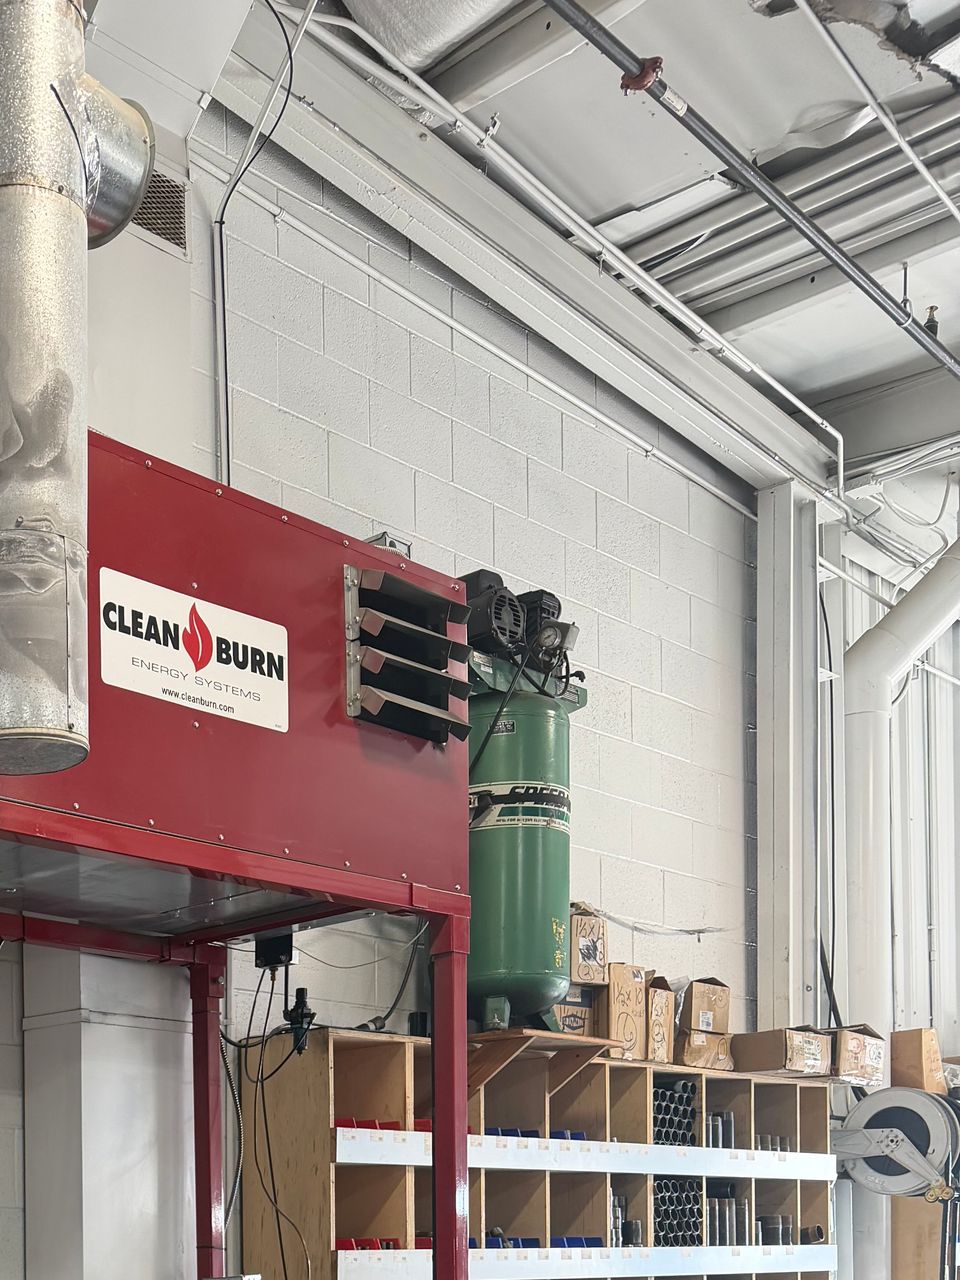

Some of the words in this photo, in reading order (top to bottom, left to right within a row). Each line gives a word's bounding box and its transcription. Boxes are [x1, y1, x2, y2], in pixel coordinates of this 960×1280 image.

[102, 601, 180, 651] CLEAN
[216, 636, 284, 682] BURN
[131, 656, 189, 681] ENERGY
[194, 675, 261, 702] SYSTEMS
[161, 686, 235, 714] www.cleanburn.com
